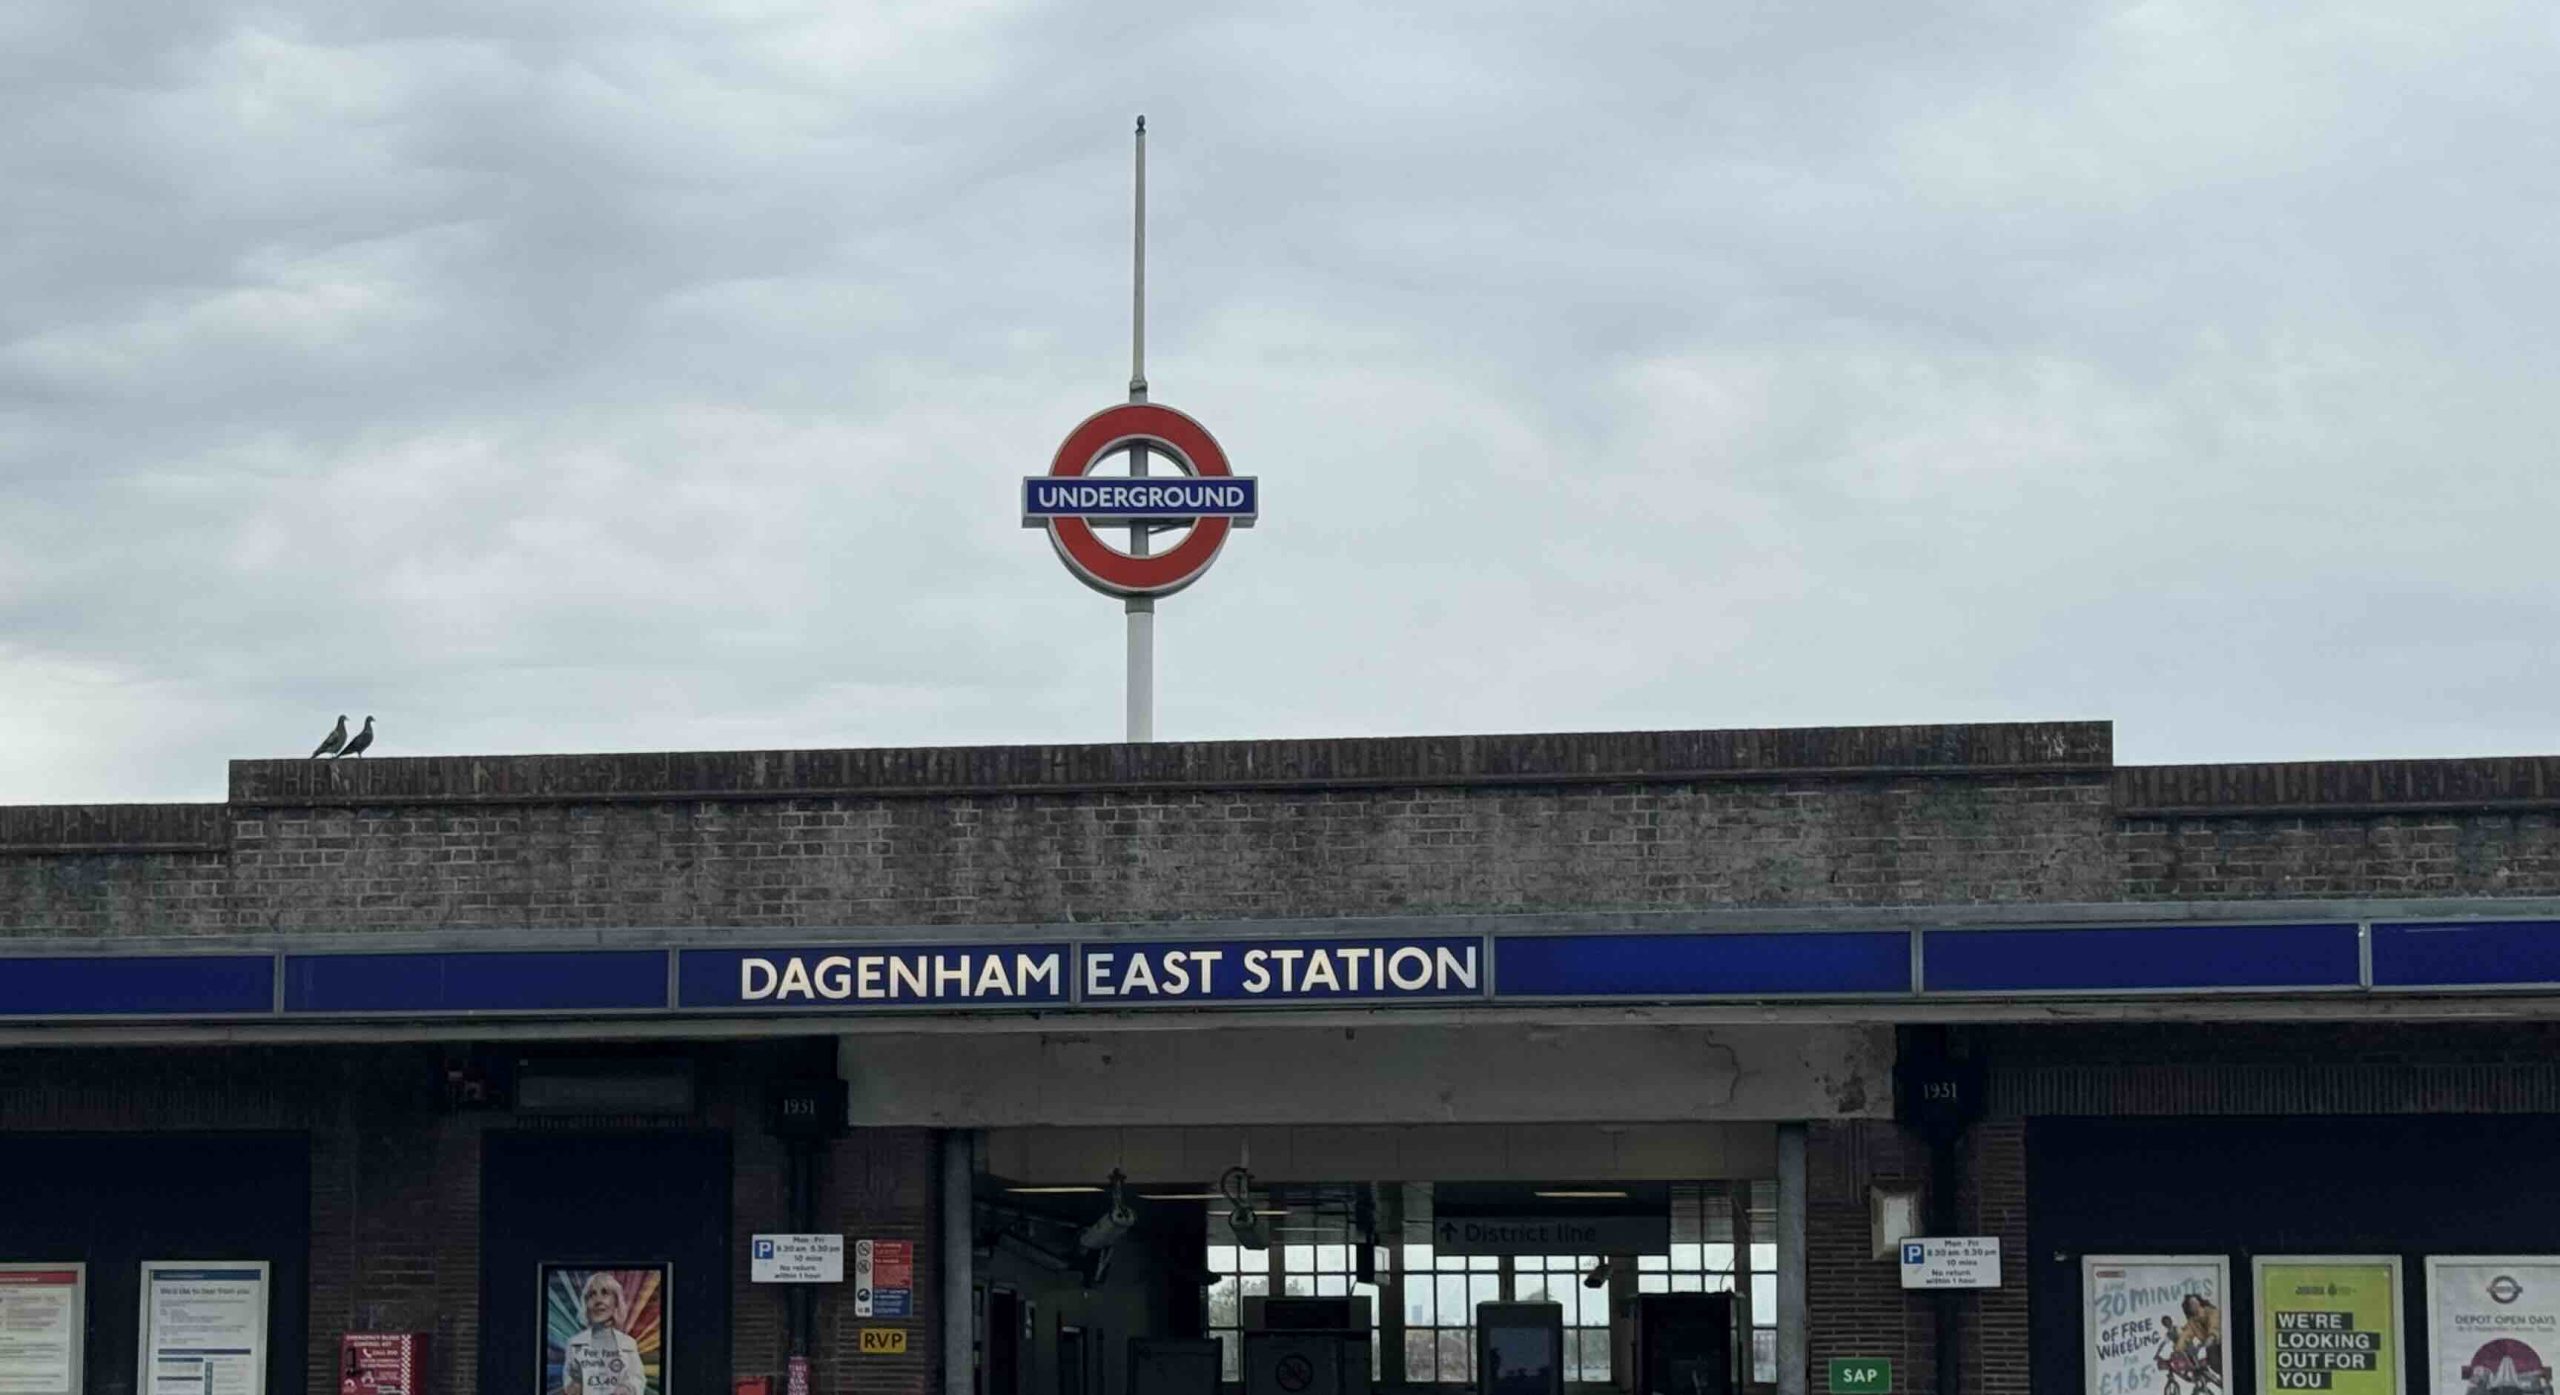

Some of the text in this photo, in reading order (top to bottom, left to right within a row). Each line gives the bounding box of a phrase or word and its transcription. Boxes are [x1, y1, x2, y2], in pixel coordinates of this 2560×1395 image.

[1038, 486, 1246, 508] UNDERGROUND
[741, 945, 1477, 1001] DAGENHAM EAST STATION
[1465, 1222, 1597, 1243] District line
[2094, 1277, 2213, 1324] 30 MINUTES
[2277, 1312, 2343, 1329] WE'RE
[2455, 1315, 2556, 1325] DEPOT OPEN DAYS
[2102, 1317, 2153, 1343] OF FREE
[864, 1332, 903, 1349] RVP
[2096, 1330, 2161, 1361] WHEELING
[2277, 1332, 2371, 1350] LOOKING
[584, 1349, 598, 1358] For
[2277, 1352, 2366, 1369] OUT FOR
[587, 1376, 618, 1386] £3.40
[1842, 1368, 1879, 1383] SAP
[2278, 1371, 2323, 1388] YOU
